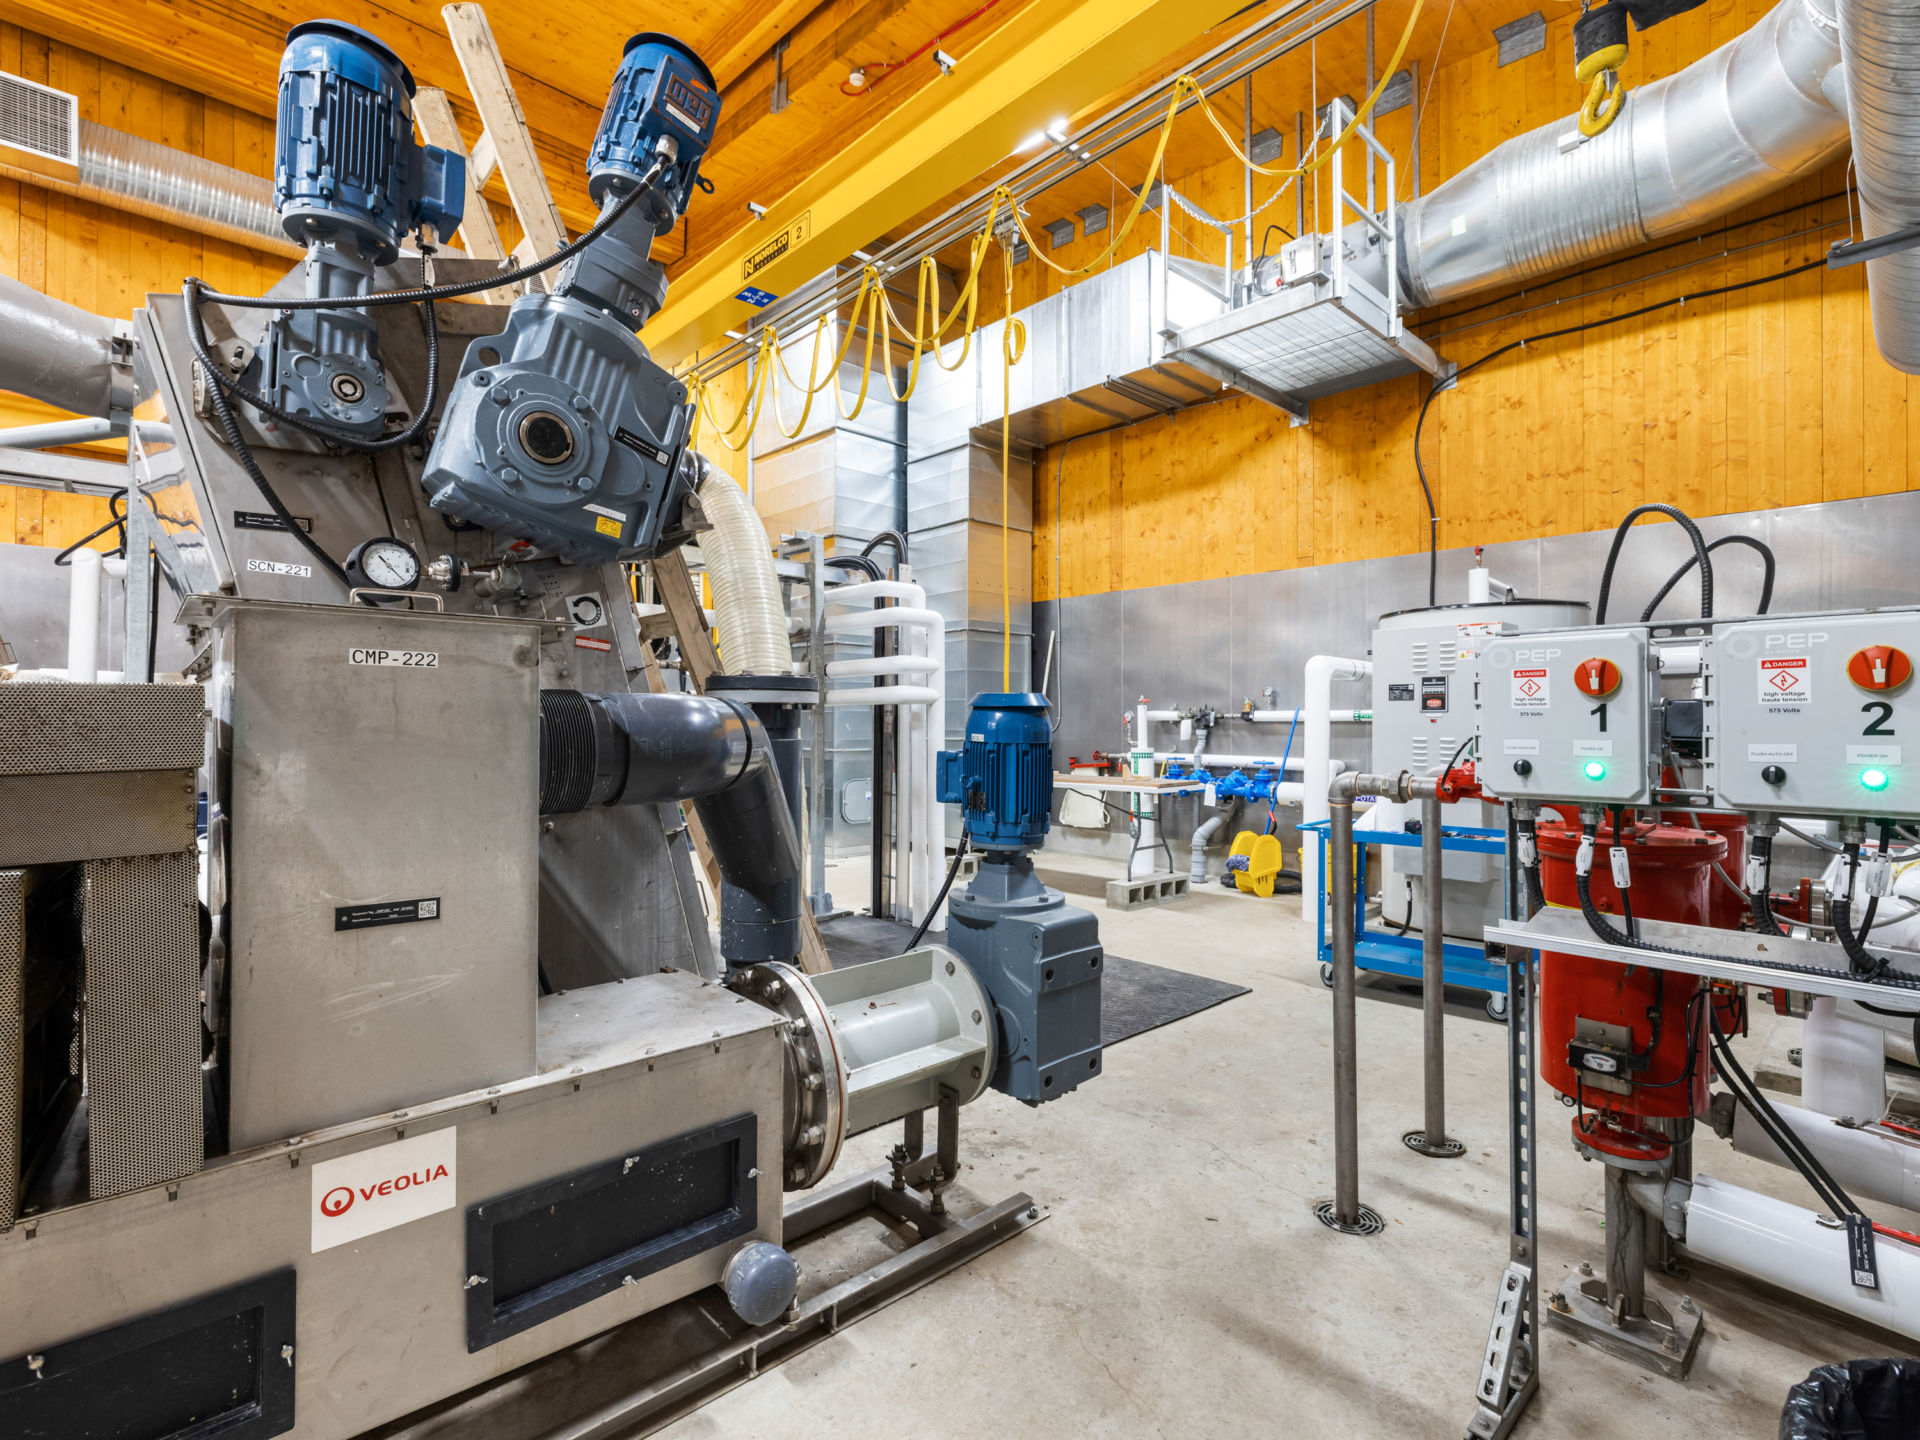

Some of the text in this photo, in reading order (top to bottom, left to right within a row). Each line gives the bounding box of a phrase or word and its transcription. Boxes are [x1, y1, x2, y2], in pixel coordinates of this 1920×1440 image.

[796, 226, 802, 240] 2
[754, 233, 788, 264] NORELCO
[249, 560, 309, 576] SCN-221
[1766, 632, 1829, 649] PEP
[352, 649, 436, 667] CMP-222
[1515, 649, 1562, 662] PEP
[1590, 703, 1607, 732] 1
[1861, 701, 1895, 736] 2
[359, 1164, 449, 1201] VEOLIA
